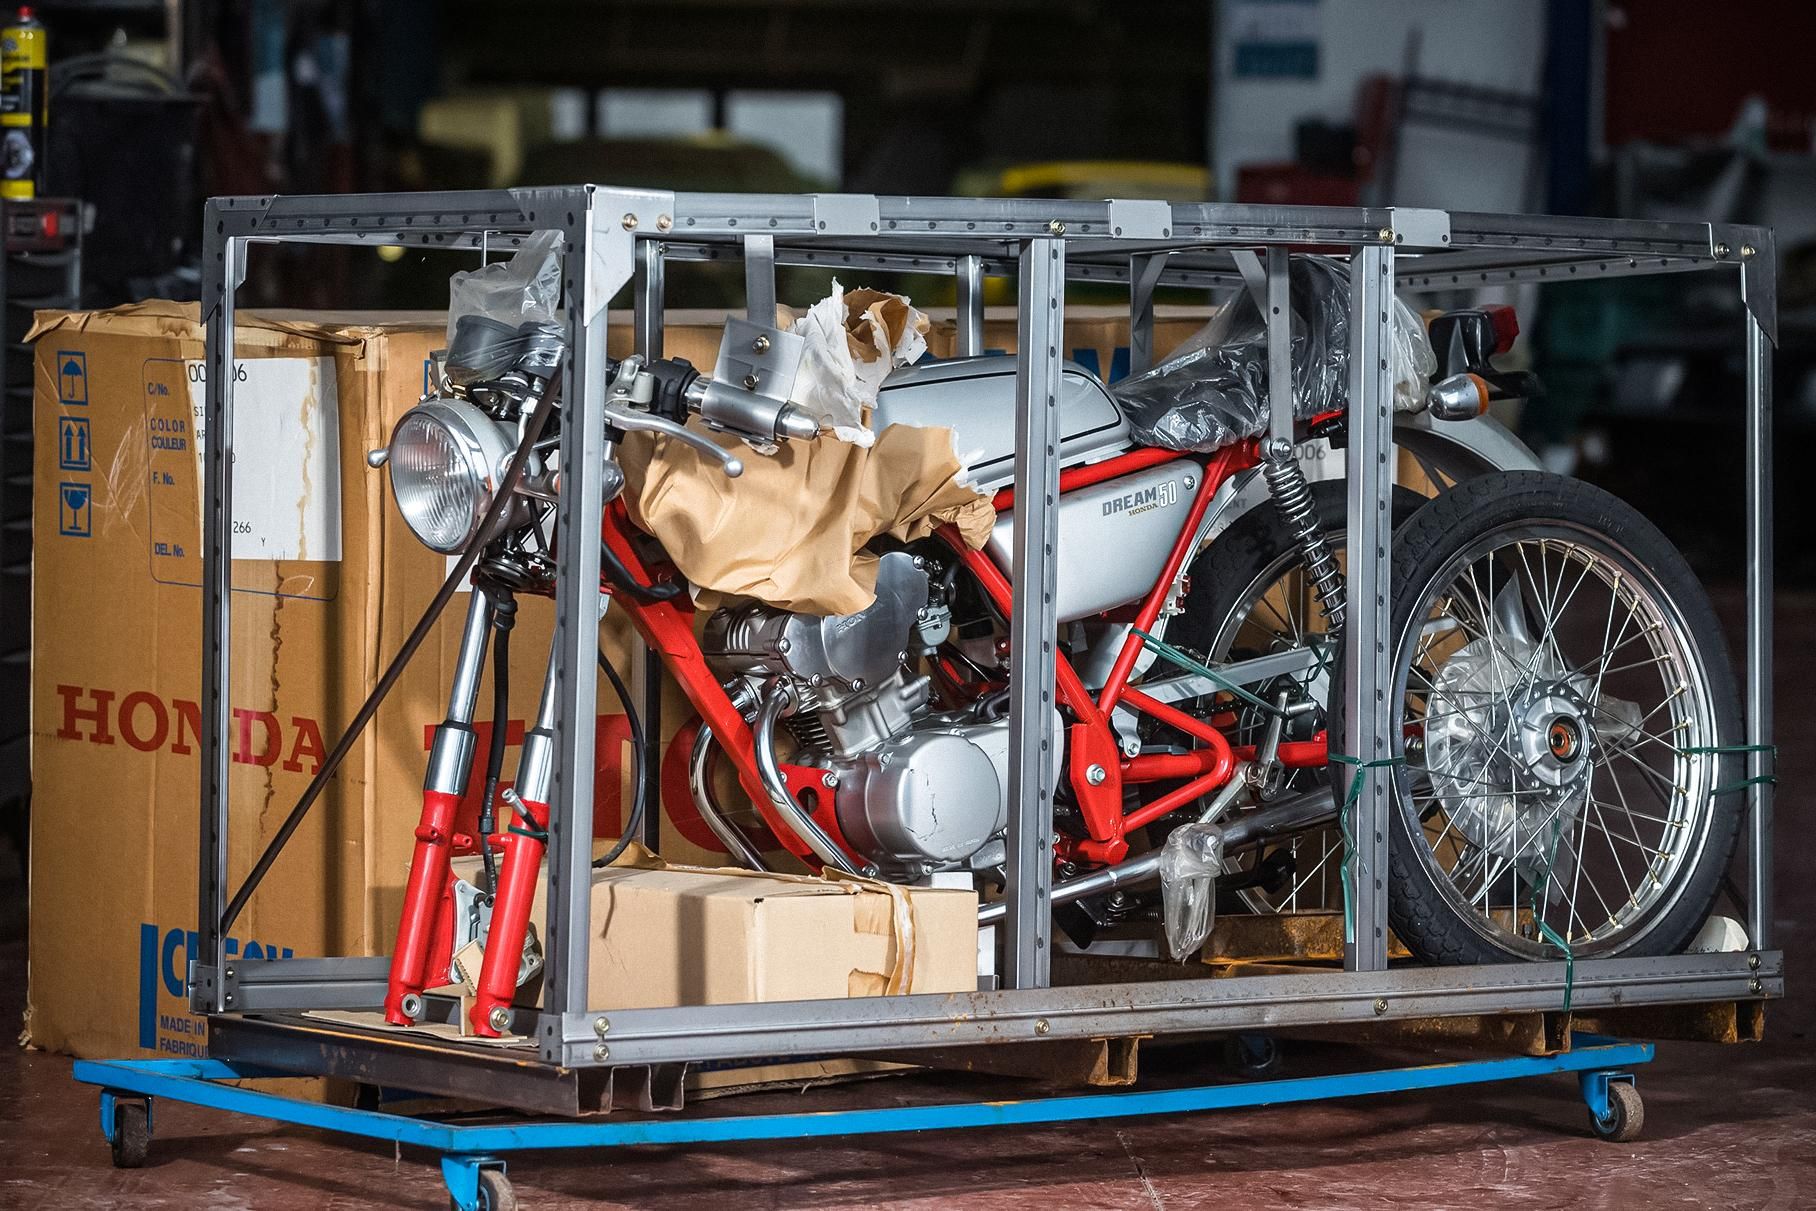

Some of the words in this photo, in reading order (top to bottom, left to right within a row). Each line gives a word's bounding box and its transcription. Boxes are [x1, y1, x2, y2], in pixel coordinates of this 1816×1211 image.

[150, 418, 185, 433] COLOR
[152, 436, 187, 450] COULEUR
[1103, 487, 1157, 516] DREAM
[1159, 480, 1177, 508] 50
[1128, 502, 1158, 516] HONDA
[160, 1015, 191, 1033] MADE
[194, 1020, 206, 1036] IN
[160, 1037, 209, 1058] FABRIQU
